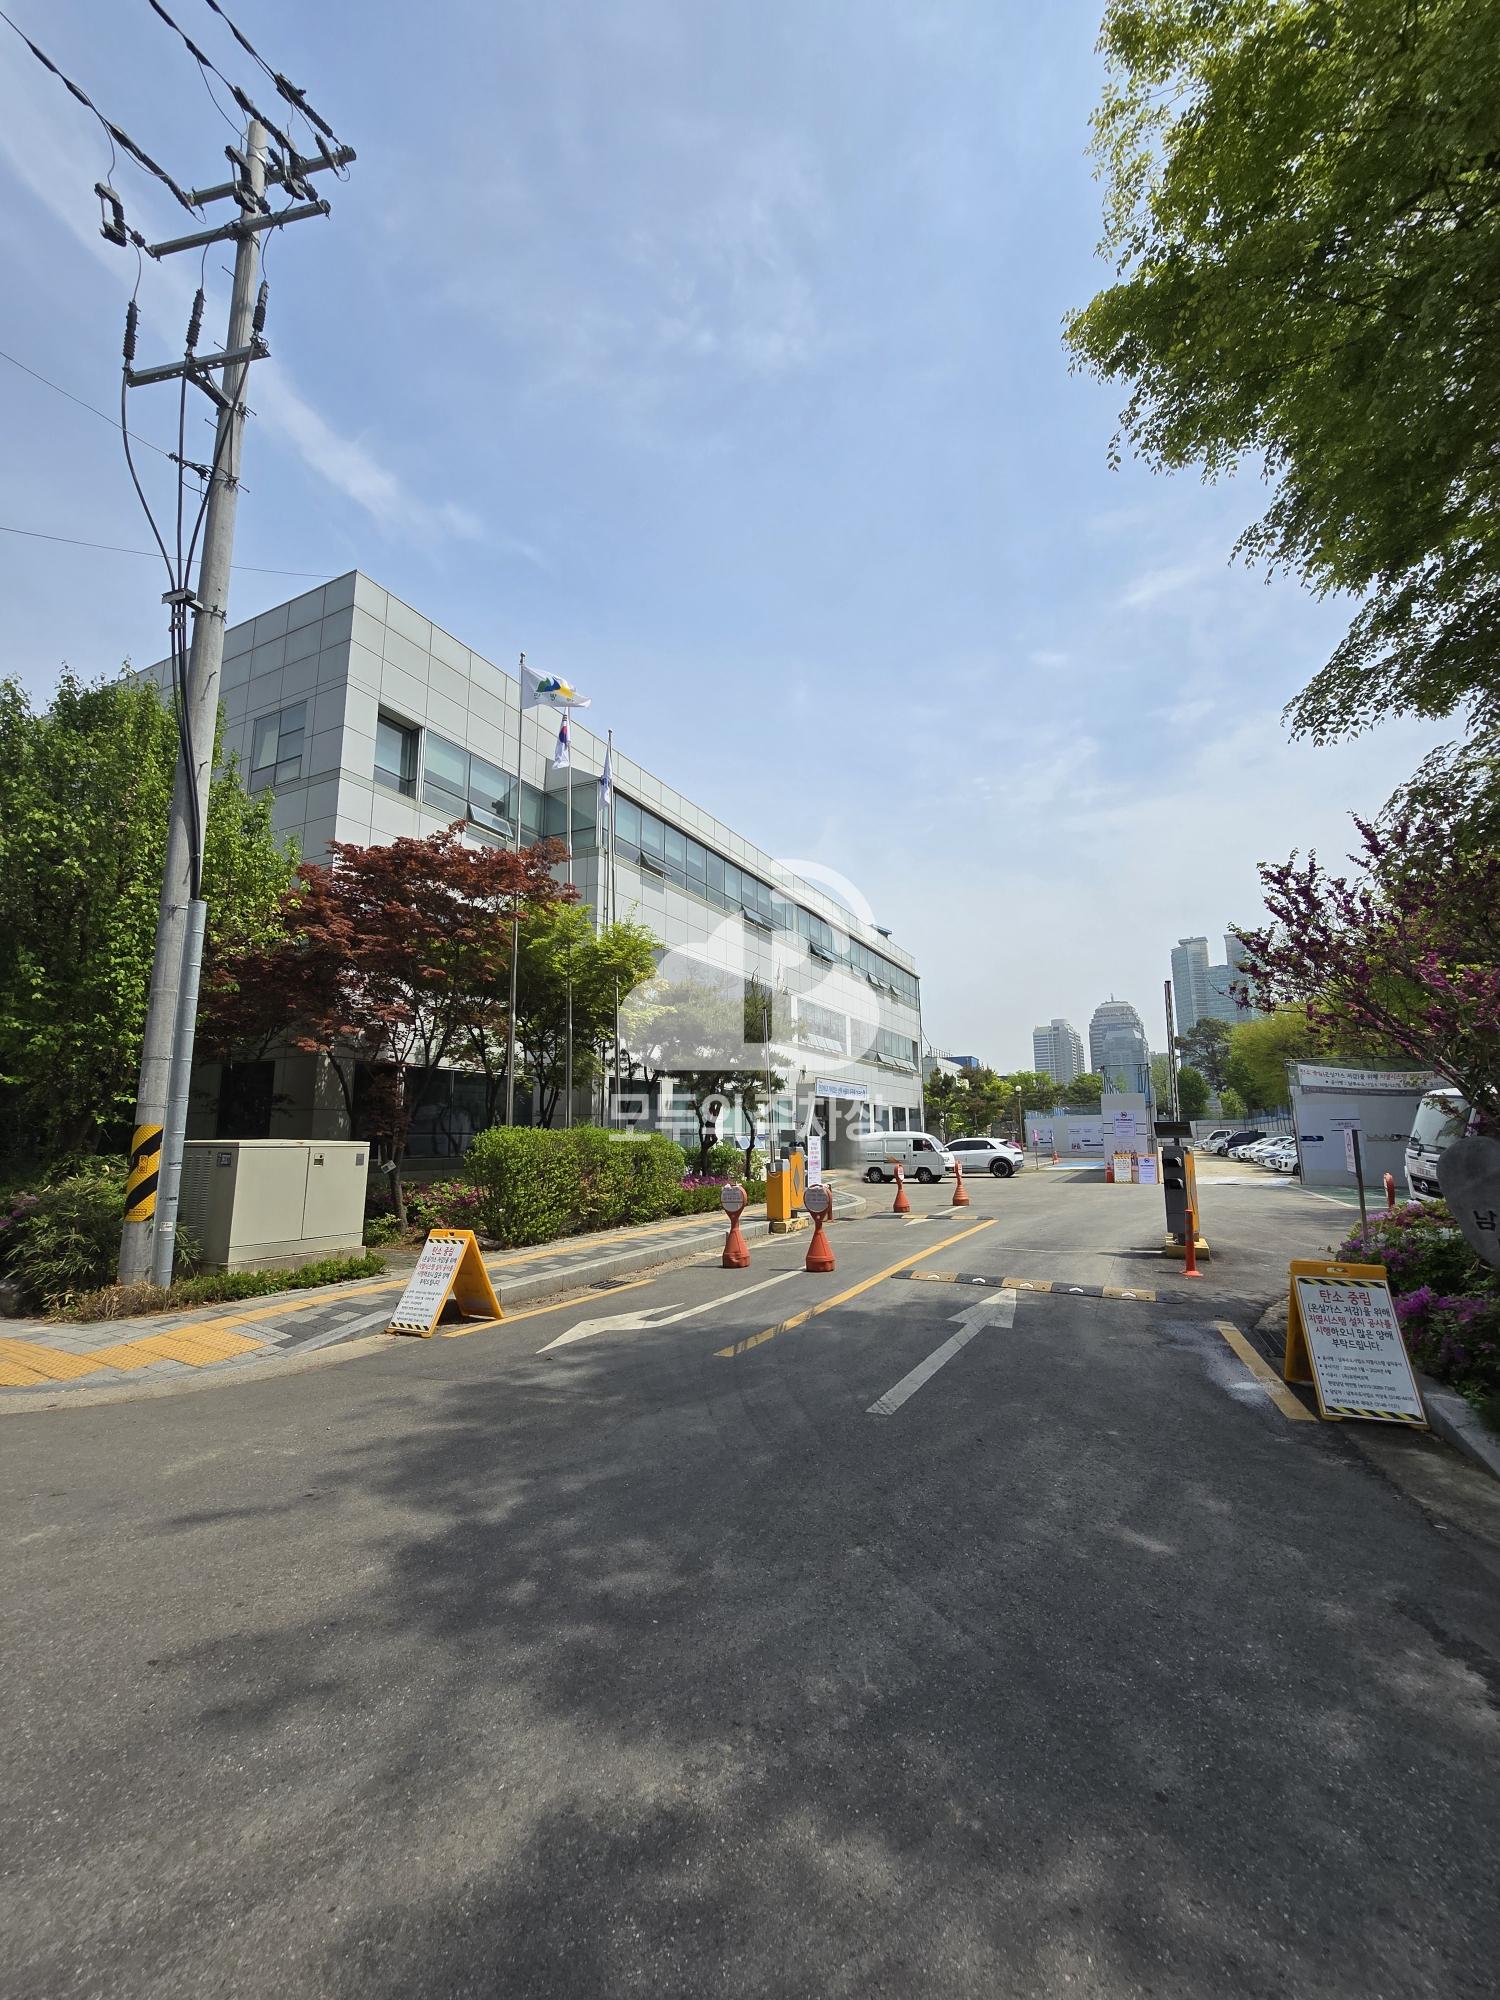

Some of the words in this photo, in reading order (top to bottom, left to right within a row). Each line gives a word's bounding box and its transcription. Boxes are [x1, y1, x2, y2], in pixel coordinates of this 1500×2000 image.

[1319, 1289, 1344, 1304] 탄소
[1347, 1291, 1372, 1306] 중립
[1307, 1303, 1342, 1314] (온실가스
[1344, 1305, 1372, 1317] 저감)을
[1373, 1307, 1391, 1317] 위해
[1308, 1314, 1347, 1326] 지열시스템
[1349, 1317, 1366, 1327] 설치
[1367, 1318, 1393, 1329] 공사를
[1315, 1326, 1355, 1338] 시행하오니
[1356, 1328, 1374, 1340] 많은
[1375, 1330, 1395, 1341] 양해
